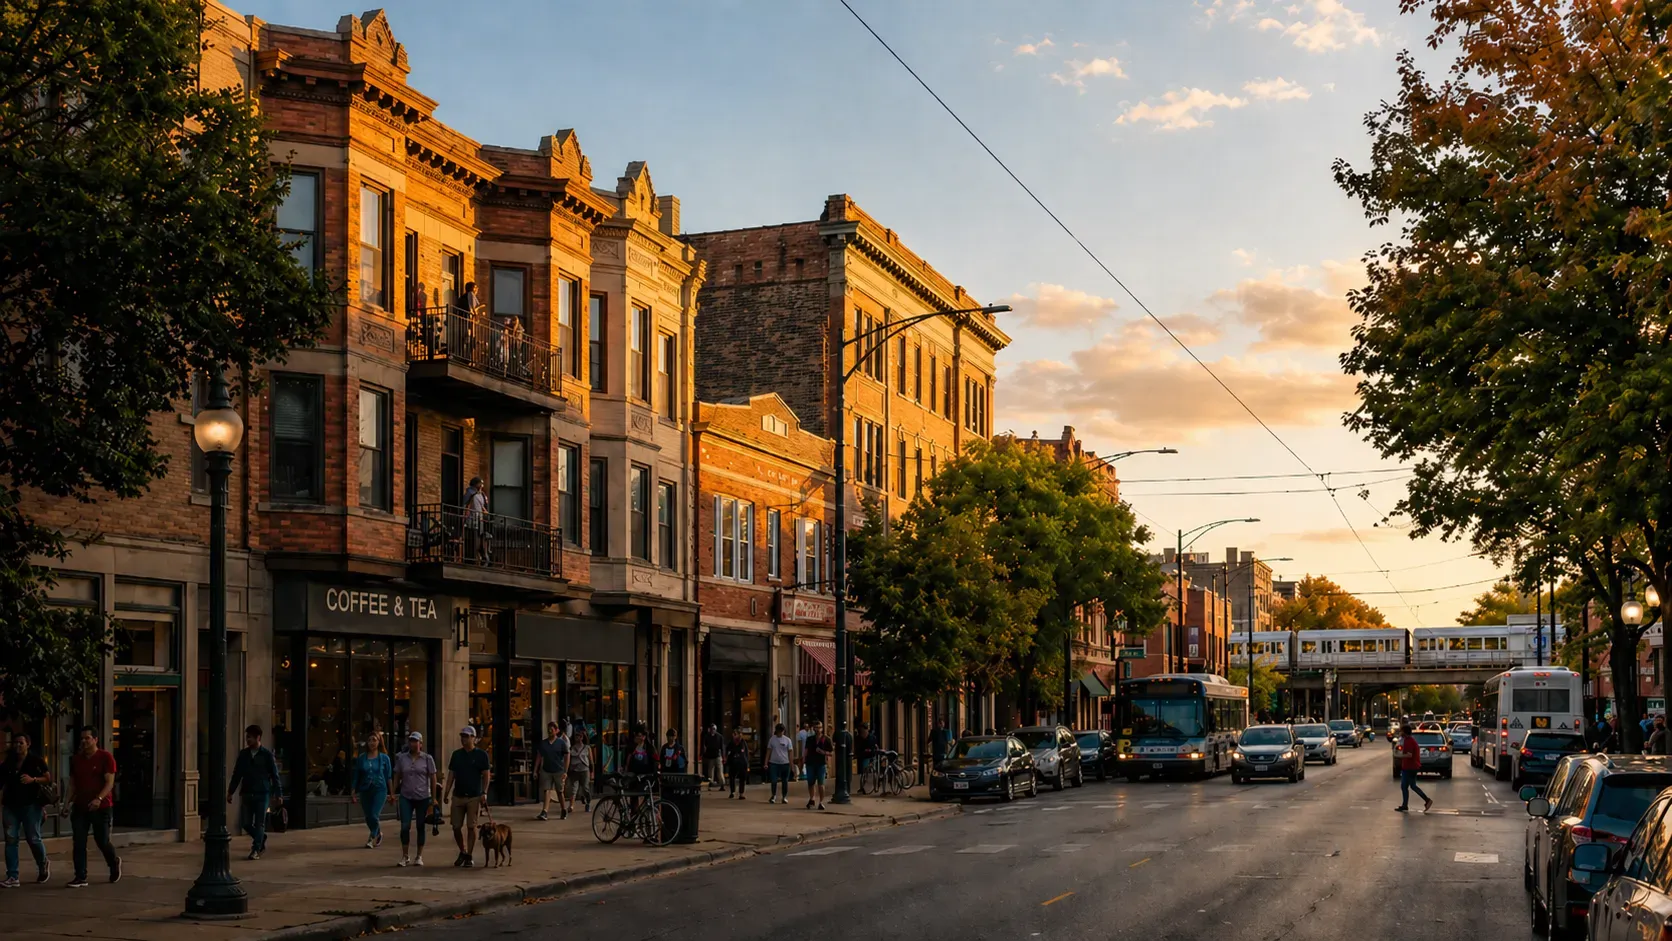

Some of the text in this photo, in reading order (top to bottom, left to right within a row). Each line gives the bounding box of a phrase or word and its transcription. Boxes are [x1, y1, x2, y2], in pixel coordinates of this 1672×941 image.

[326, 588, 437, 619] COFFEE & TEA
